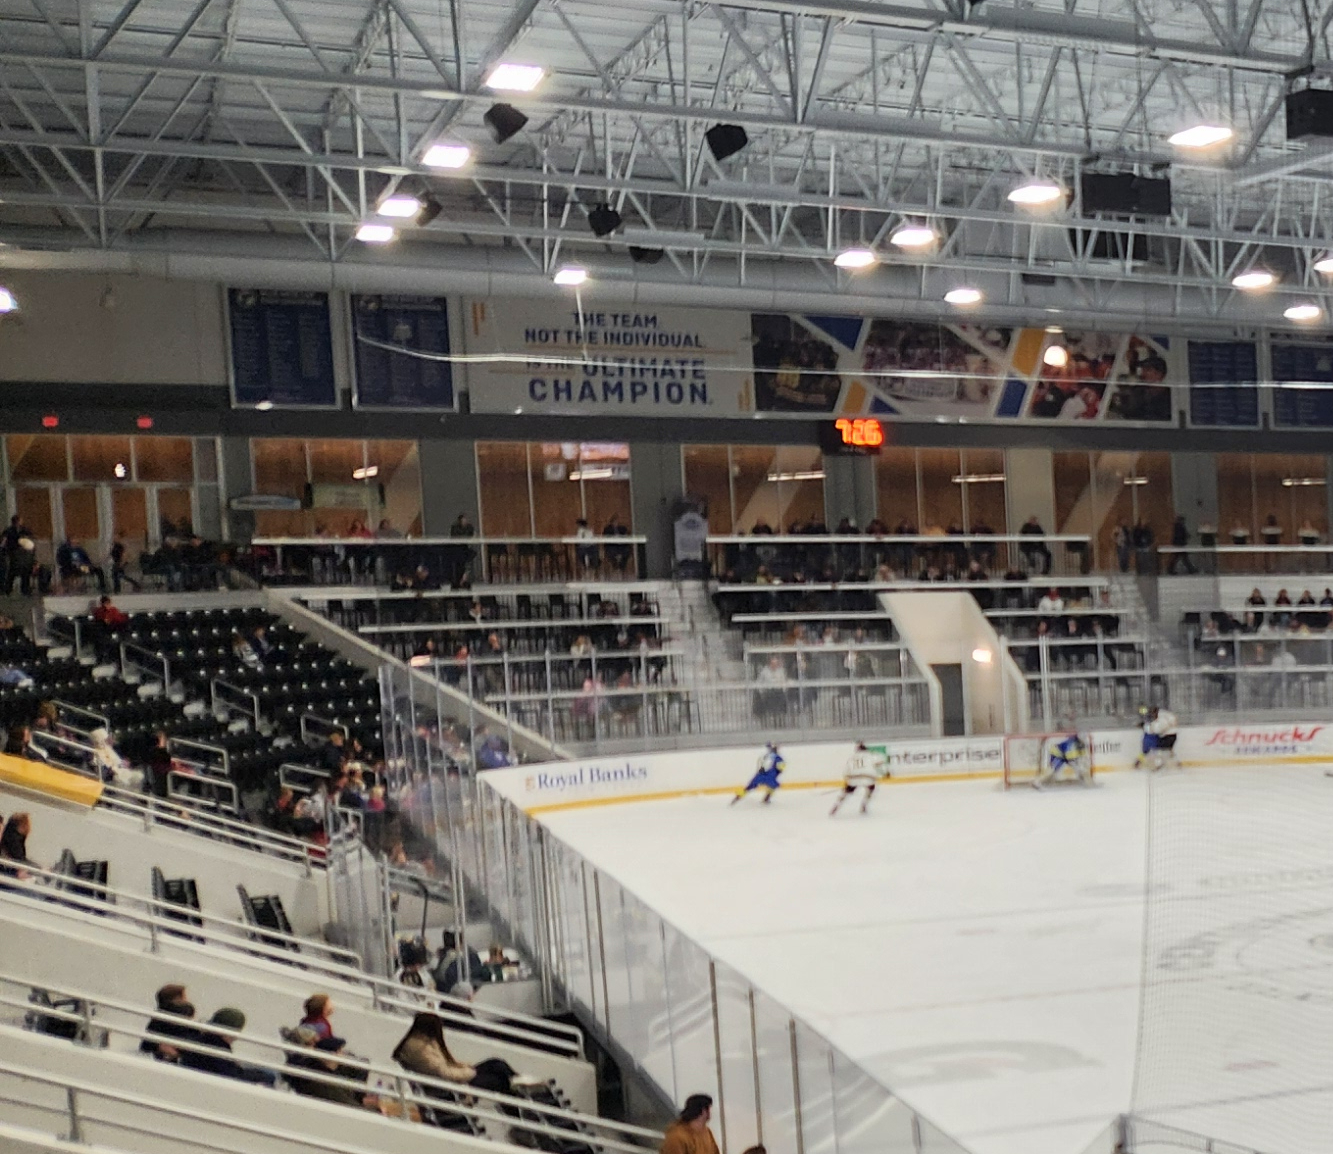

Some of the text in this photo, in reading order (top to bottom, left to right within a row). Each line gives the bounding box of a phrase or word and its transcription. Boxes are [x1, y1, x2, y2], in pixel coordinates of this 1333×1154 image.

[573, 312, 605, 327] THE
[524, 328, 559, 344] NOT
[566, 329, 599, 345] THE
[581, 358, 706, 380] ULTIMATE
[1205, 726, 1326, 747] Schnucks
[868, 744, 1000, 765] nterprise
[537, 762, 648, 790] Royal Banks
